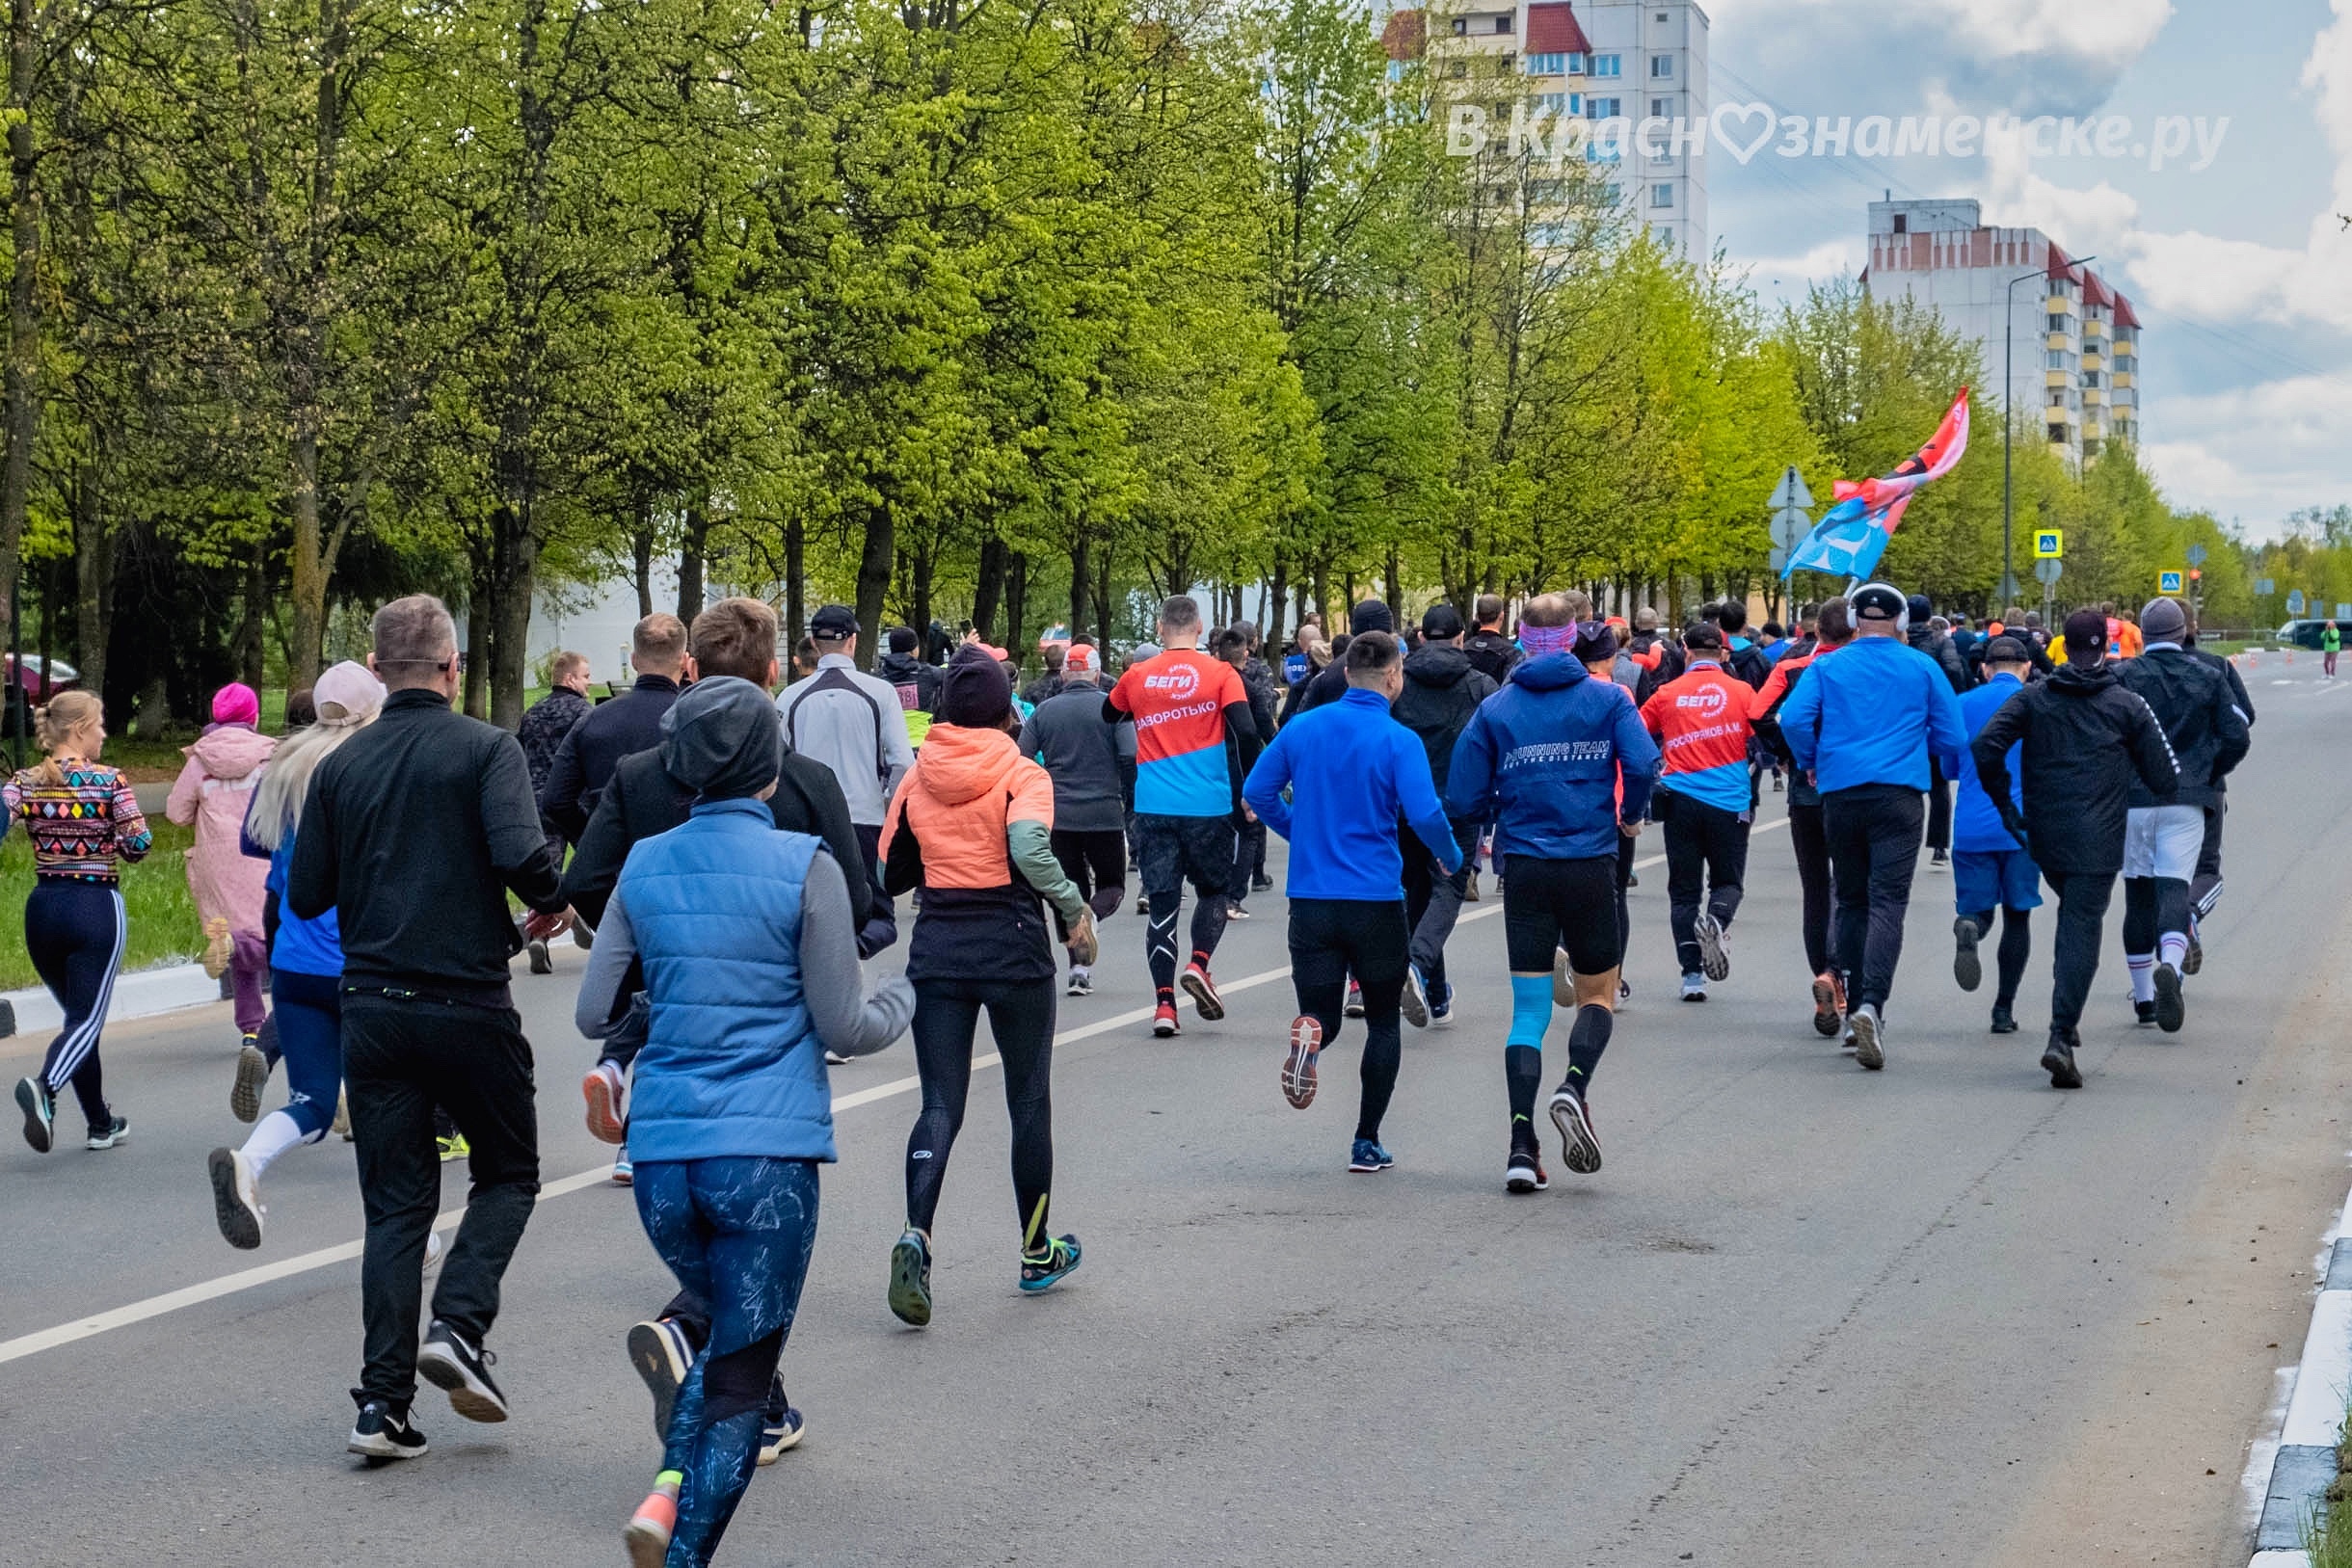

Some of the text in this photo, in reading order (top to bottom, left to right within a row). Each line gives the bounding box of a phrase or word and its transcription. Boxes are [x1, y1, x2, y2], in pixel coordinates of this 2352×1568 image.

[1144, 676, 1191, 688] БЕГИ
[1675, 695, 1721, 707] БЕГИ
[1572, 739, 1611, 755] TEAM
